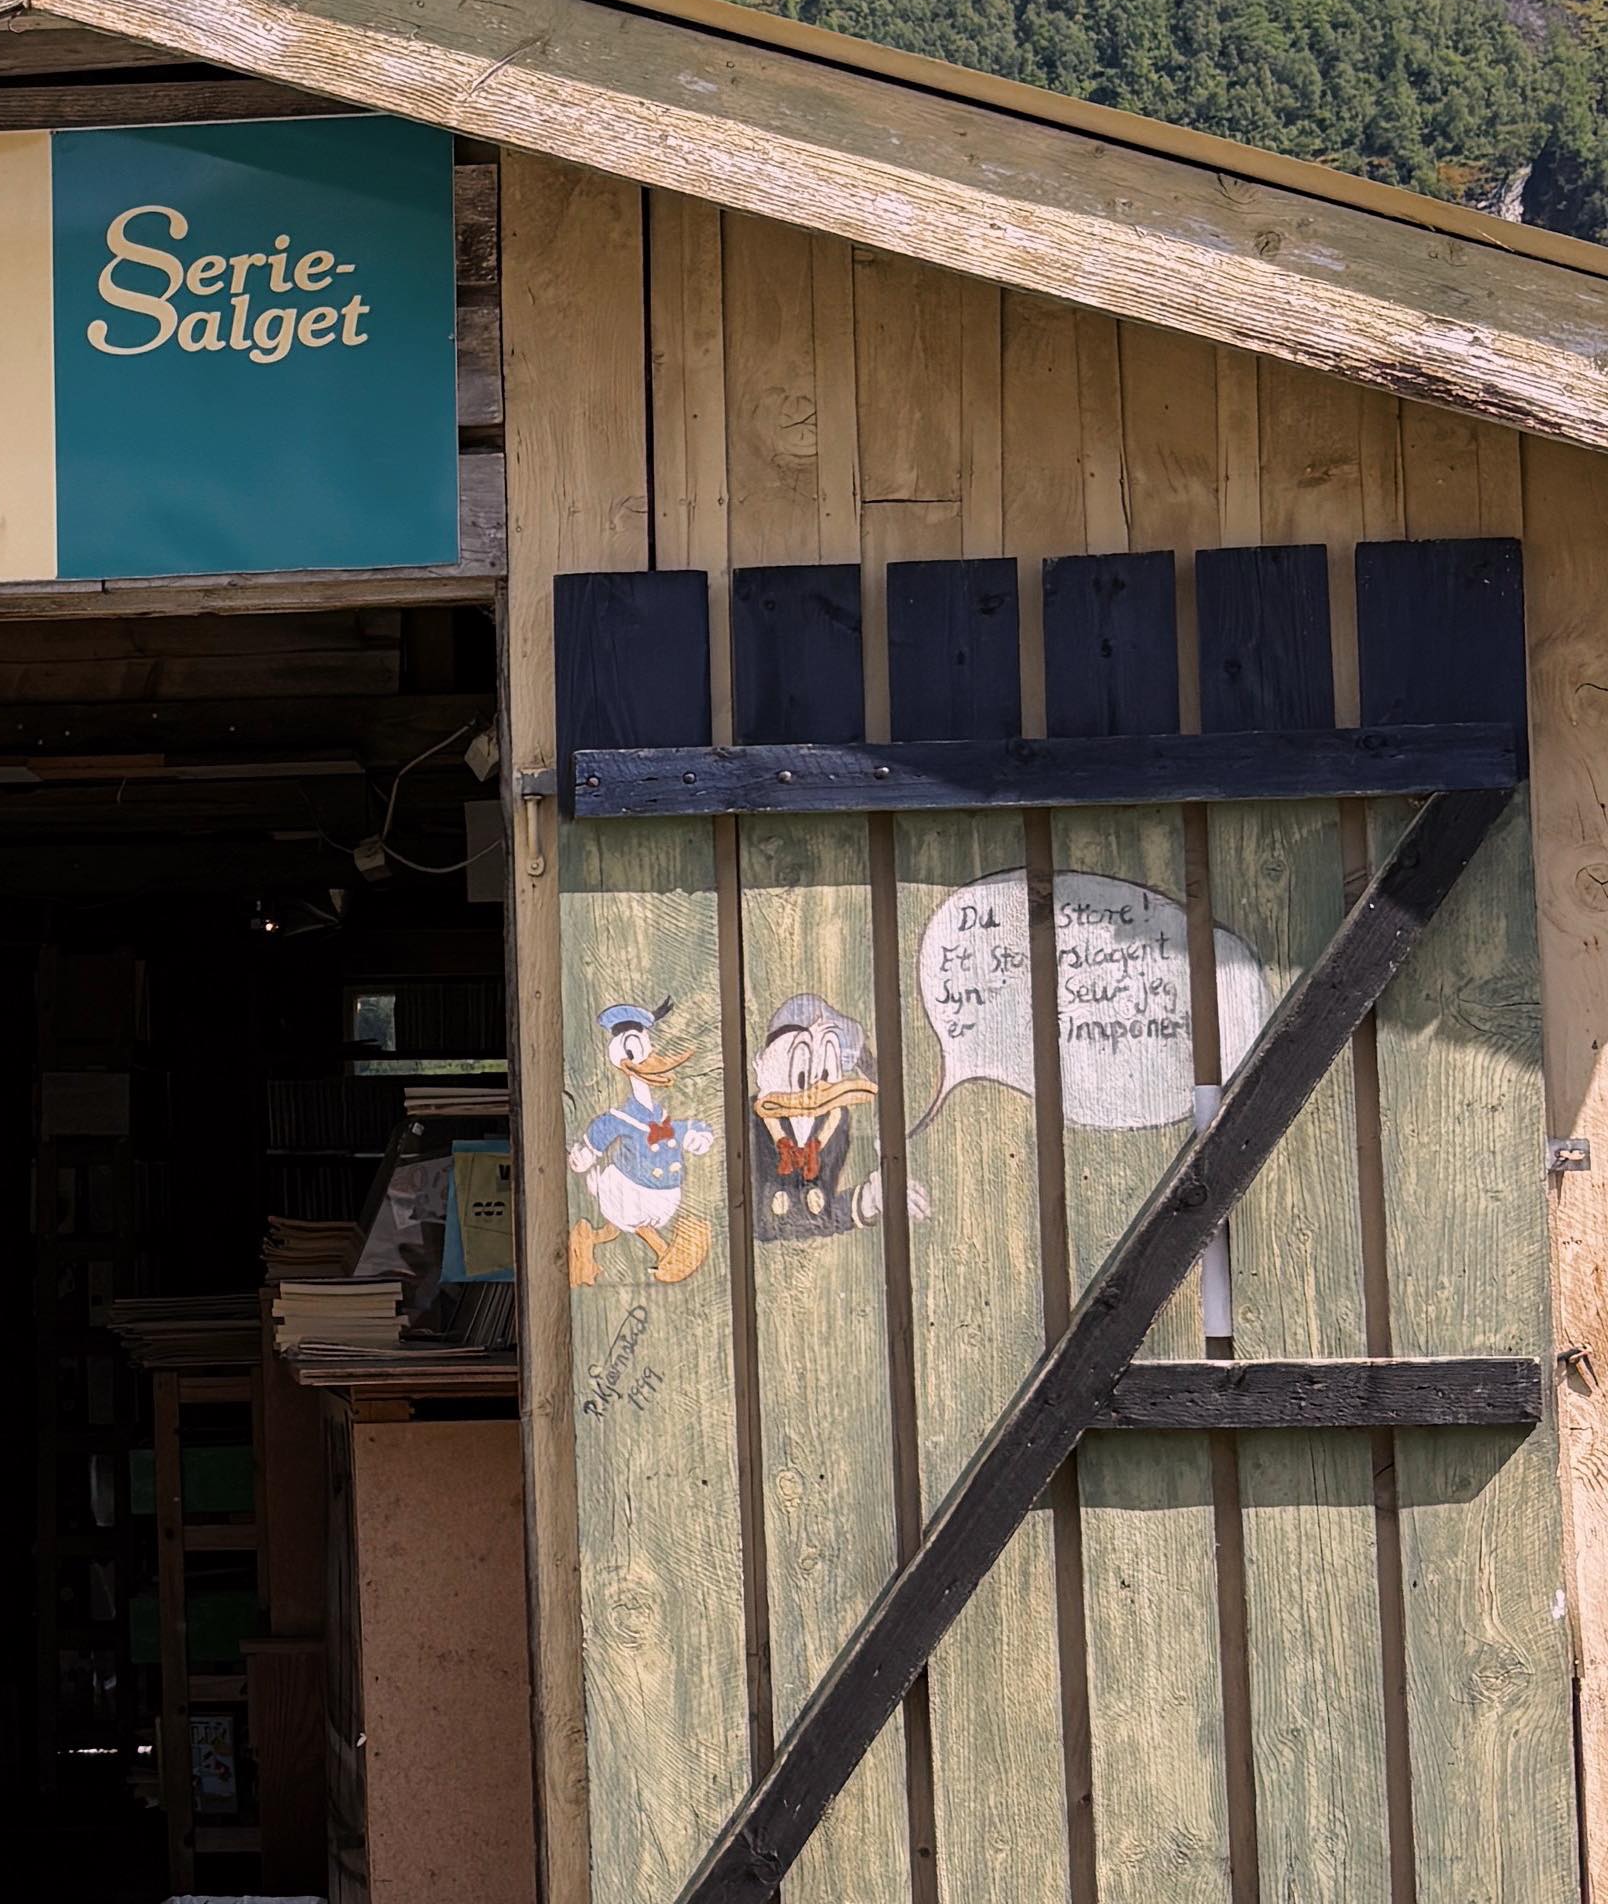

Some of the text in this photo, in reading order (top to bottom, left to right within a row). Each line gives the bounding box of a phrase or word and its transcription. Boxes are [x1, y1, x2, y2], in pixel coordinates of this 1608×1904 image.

[100, 204, 357, 302] Serie-
[87, 259, 370, 365] Salget
[958, 906, 1001, 932] Du
[939, 944, 973, 973] Et
[935, 979, 985, 1015] Syn
[1134, 972, 1178, 1014] jeg
[946, 1019, 976, 1040] er
